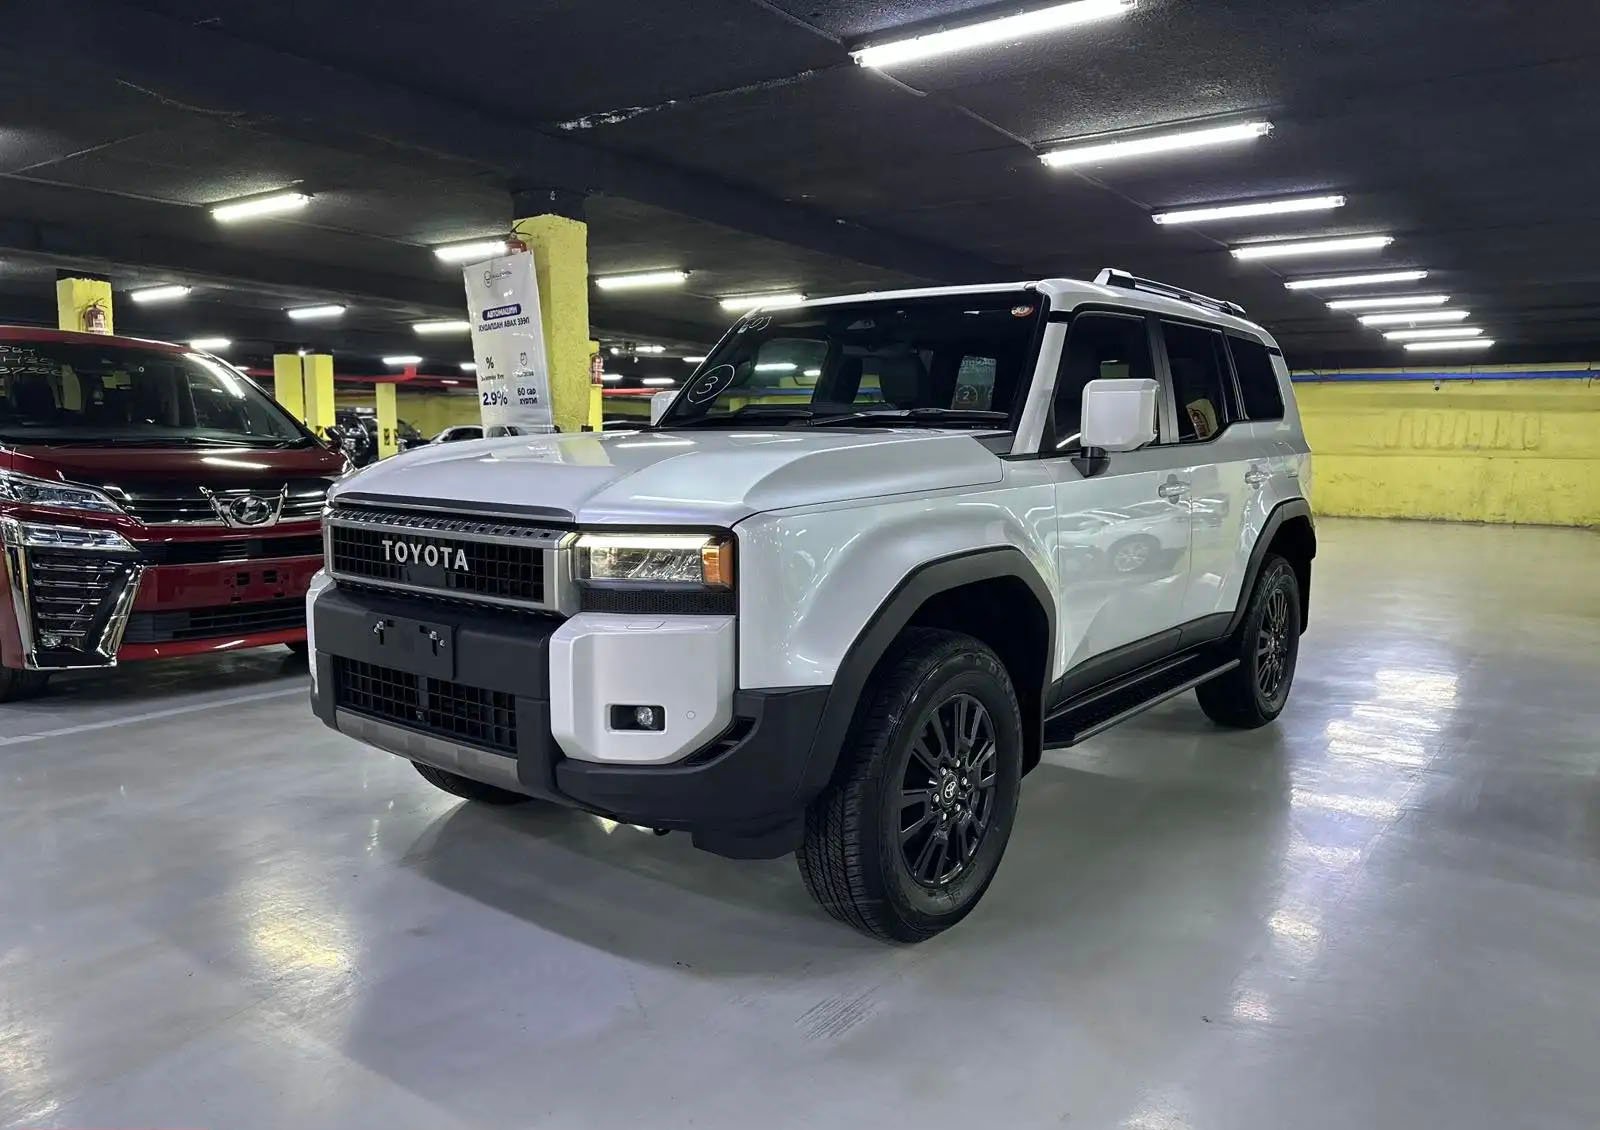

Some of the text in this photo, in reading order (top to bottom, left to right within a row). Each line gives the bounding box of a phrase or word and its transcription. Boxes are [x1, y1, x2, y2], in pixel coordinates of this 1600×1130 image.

[487, 306, 518, 319] АВТОМАШИН
[504, 318, 517, 328] АВАХ
[518, 387, 526, 396] 60
[696, 376, 718, 394] 3
[482, 391, 508, 406] 2.9%
[382, 540, 469, 571] TOYOTA
